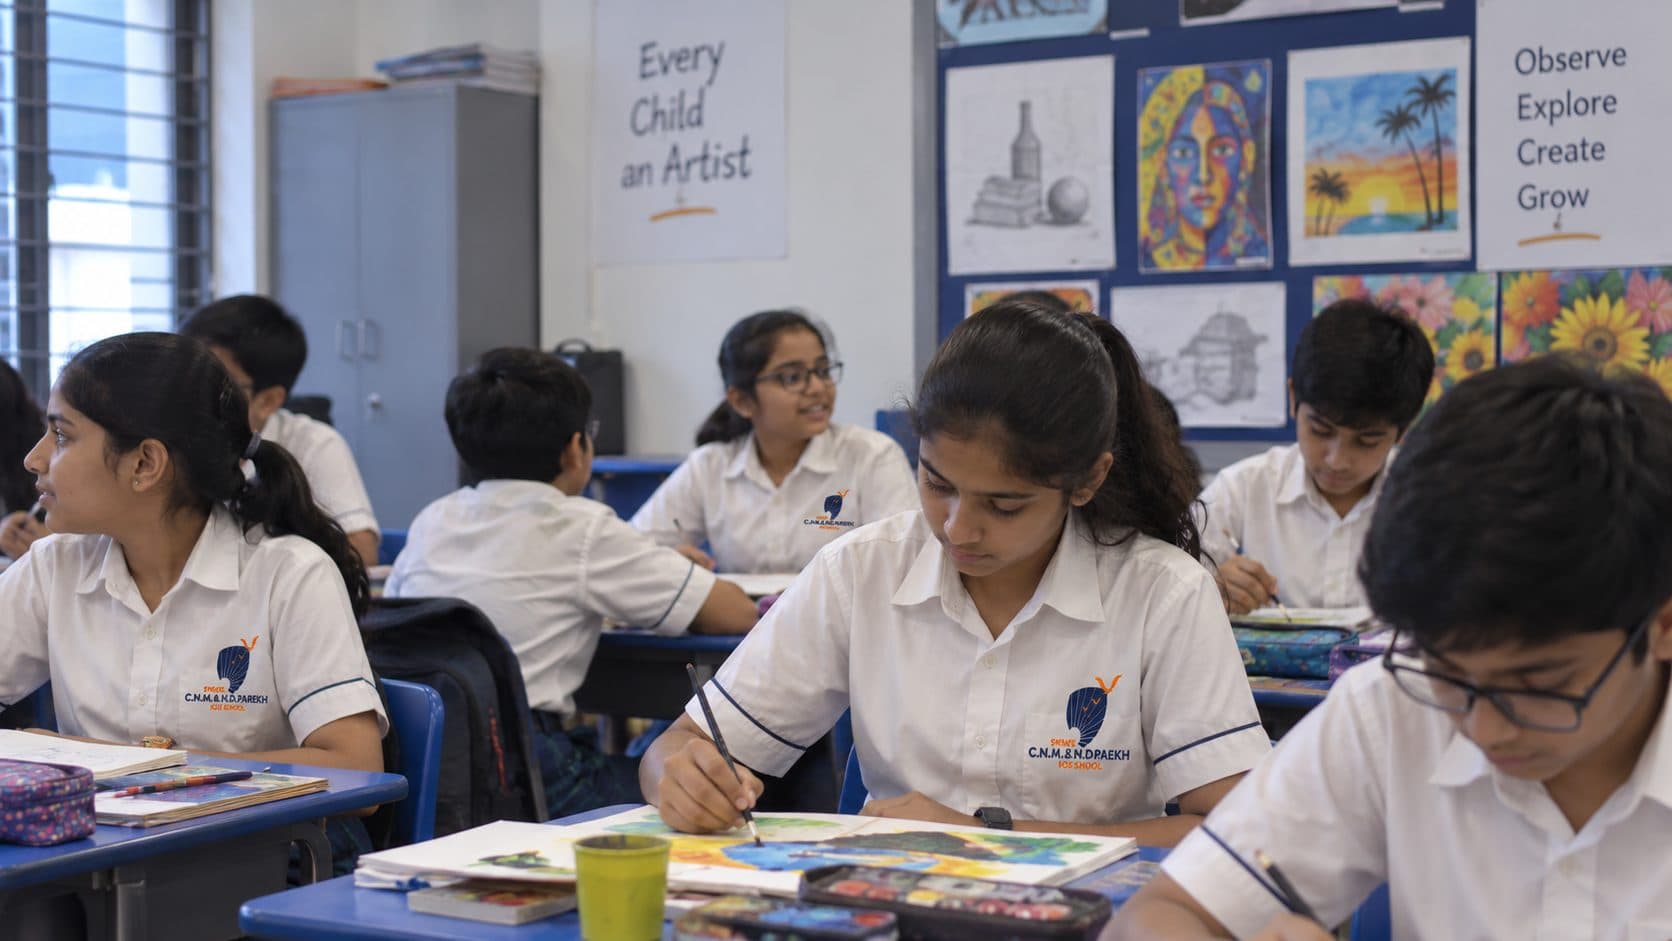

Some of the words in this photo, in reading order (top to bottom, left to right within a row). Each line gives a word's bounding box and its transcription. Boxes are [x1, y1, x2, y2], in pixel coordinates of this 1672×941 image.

[639, 41, 725, 86] Every
[1514, 46, 1627, 75] Observe
[630, 86, 705, 136] Child
[1517, 89, 1617, 126] Explore
[621, 163, 653, 188] an
[662, 134, 752, 184] Artist
[1517, 137, 1606, 166] Create
[1517, 184, 1590, 211] Grow
